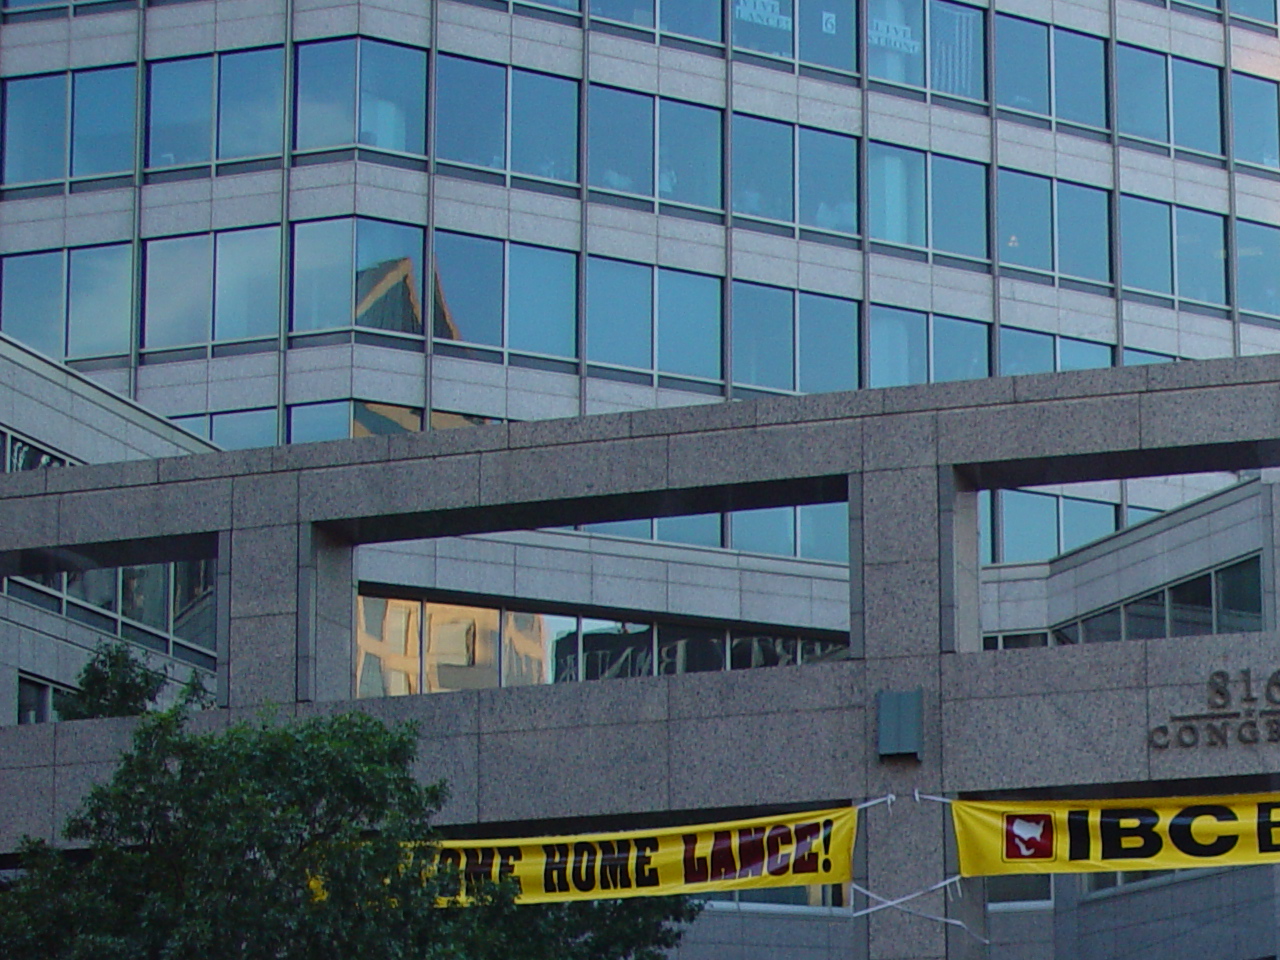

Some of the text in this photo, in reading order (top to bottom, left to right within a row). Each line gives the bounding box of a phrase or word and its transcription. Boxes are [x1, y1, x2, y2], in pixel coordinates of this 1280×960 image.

[824, 16, 835, 31] 6
[542, 836, 660, 894] HOME
[682, 820, 834, 884] LANCE!
[1067, 803, 1240, 861] IBC
